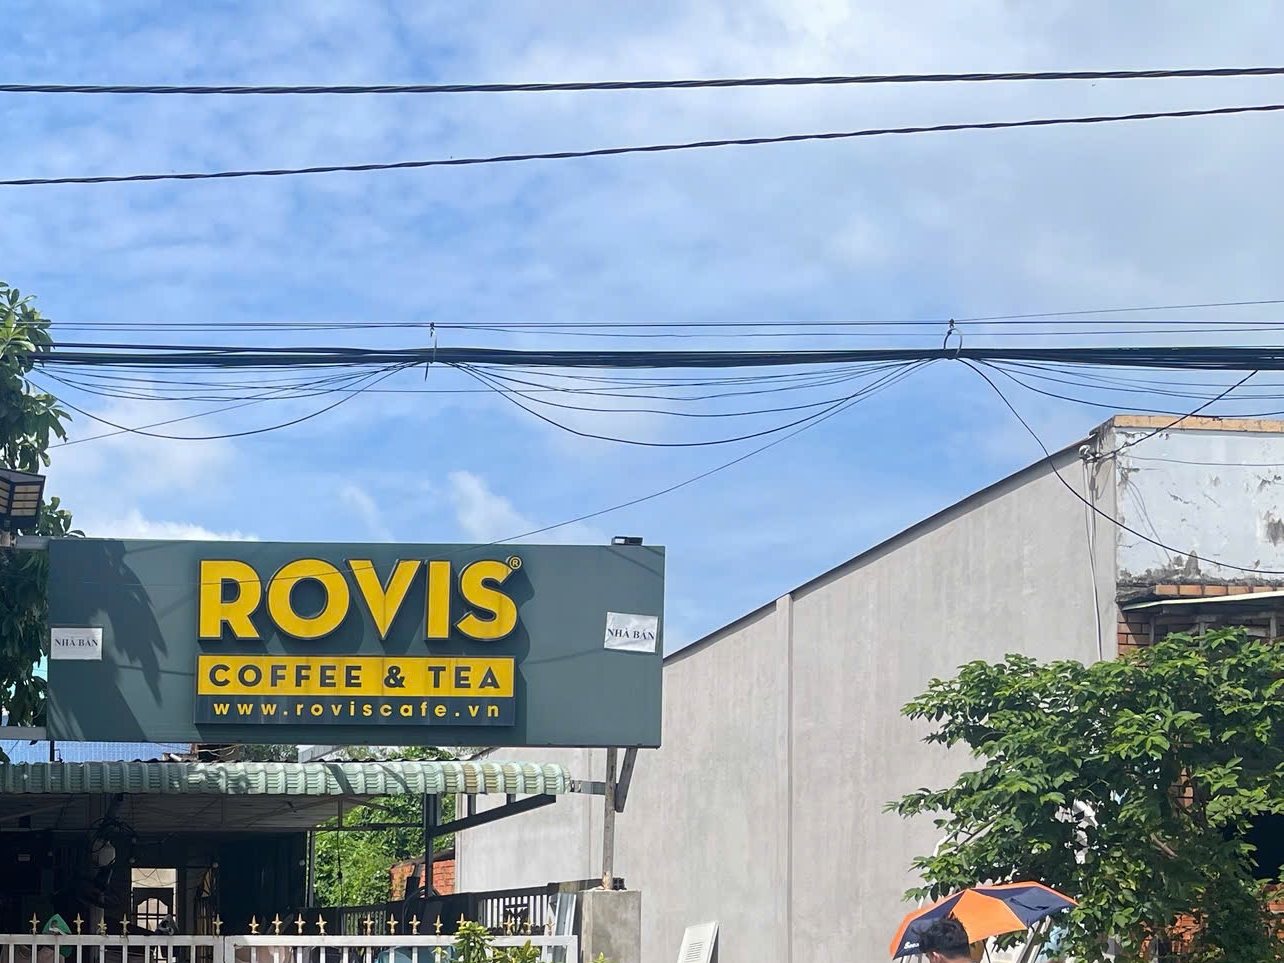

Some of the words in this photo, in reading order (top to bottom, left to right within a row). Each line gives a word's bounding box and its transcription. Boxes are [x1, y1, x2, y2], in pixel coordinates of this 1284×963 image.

[208, 663, 363, 688] COFFEE
[383, 665, 406, 689] &
[427, 665, 501, 689] TEA
[213, 700, 500, 718] www.roviscafe.vn
